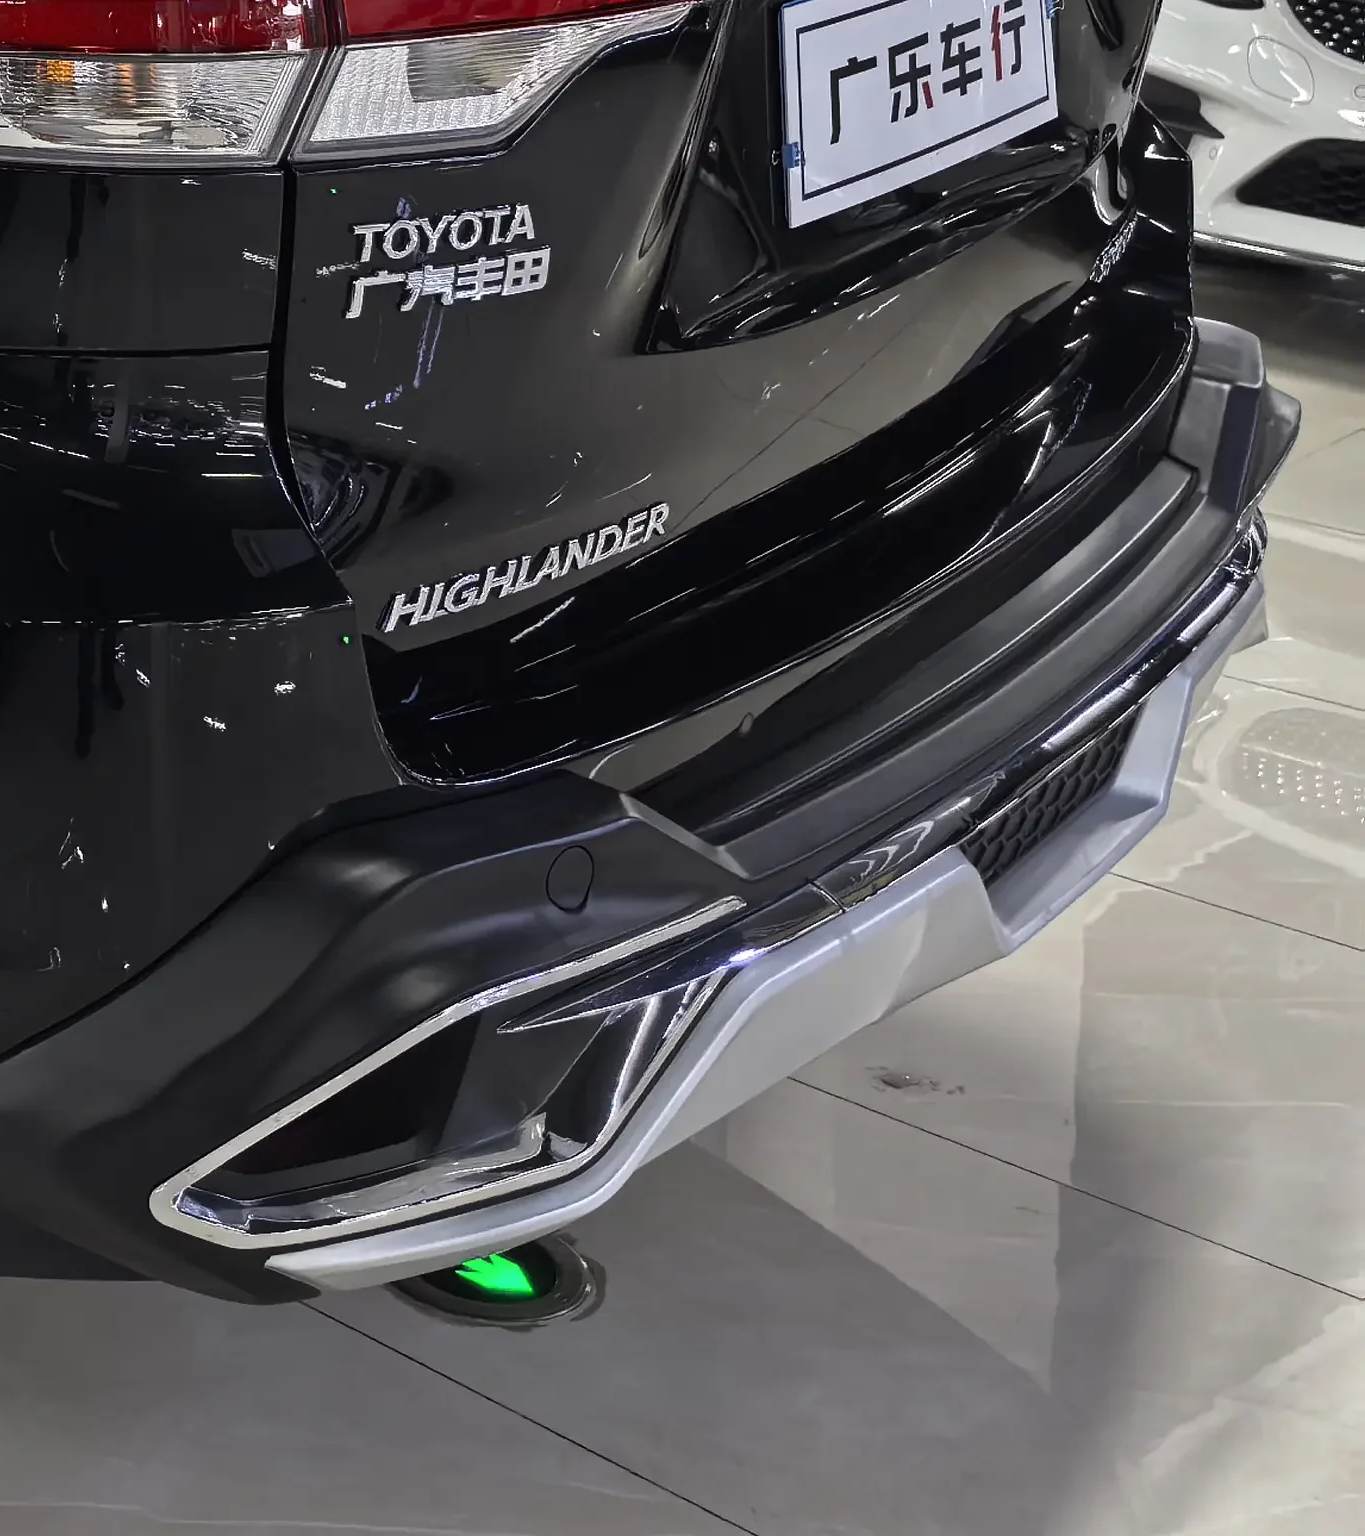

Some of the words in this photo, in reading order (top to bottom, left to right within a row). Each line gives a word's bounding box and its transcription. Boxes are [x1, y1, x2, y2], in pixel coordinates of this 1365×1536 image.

[353, 202, 536, 263] TOYOTA
[345, 244, 551, 320] 广汽丰田
[381, 502, 670, 633] HIGHLANDER
